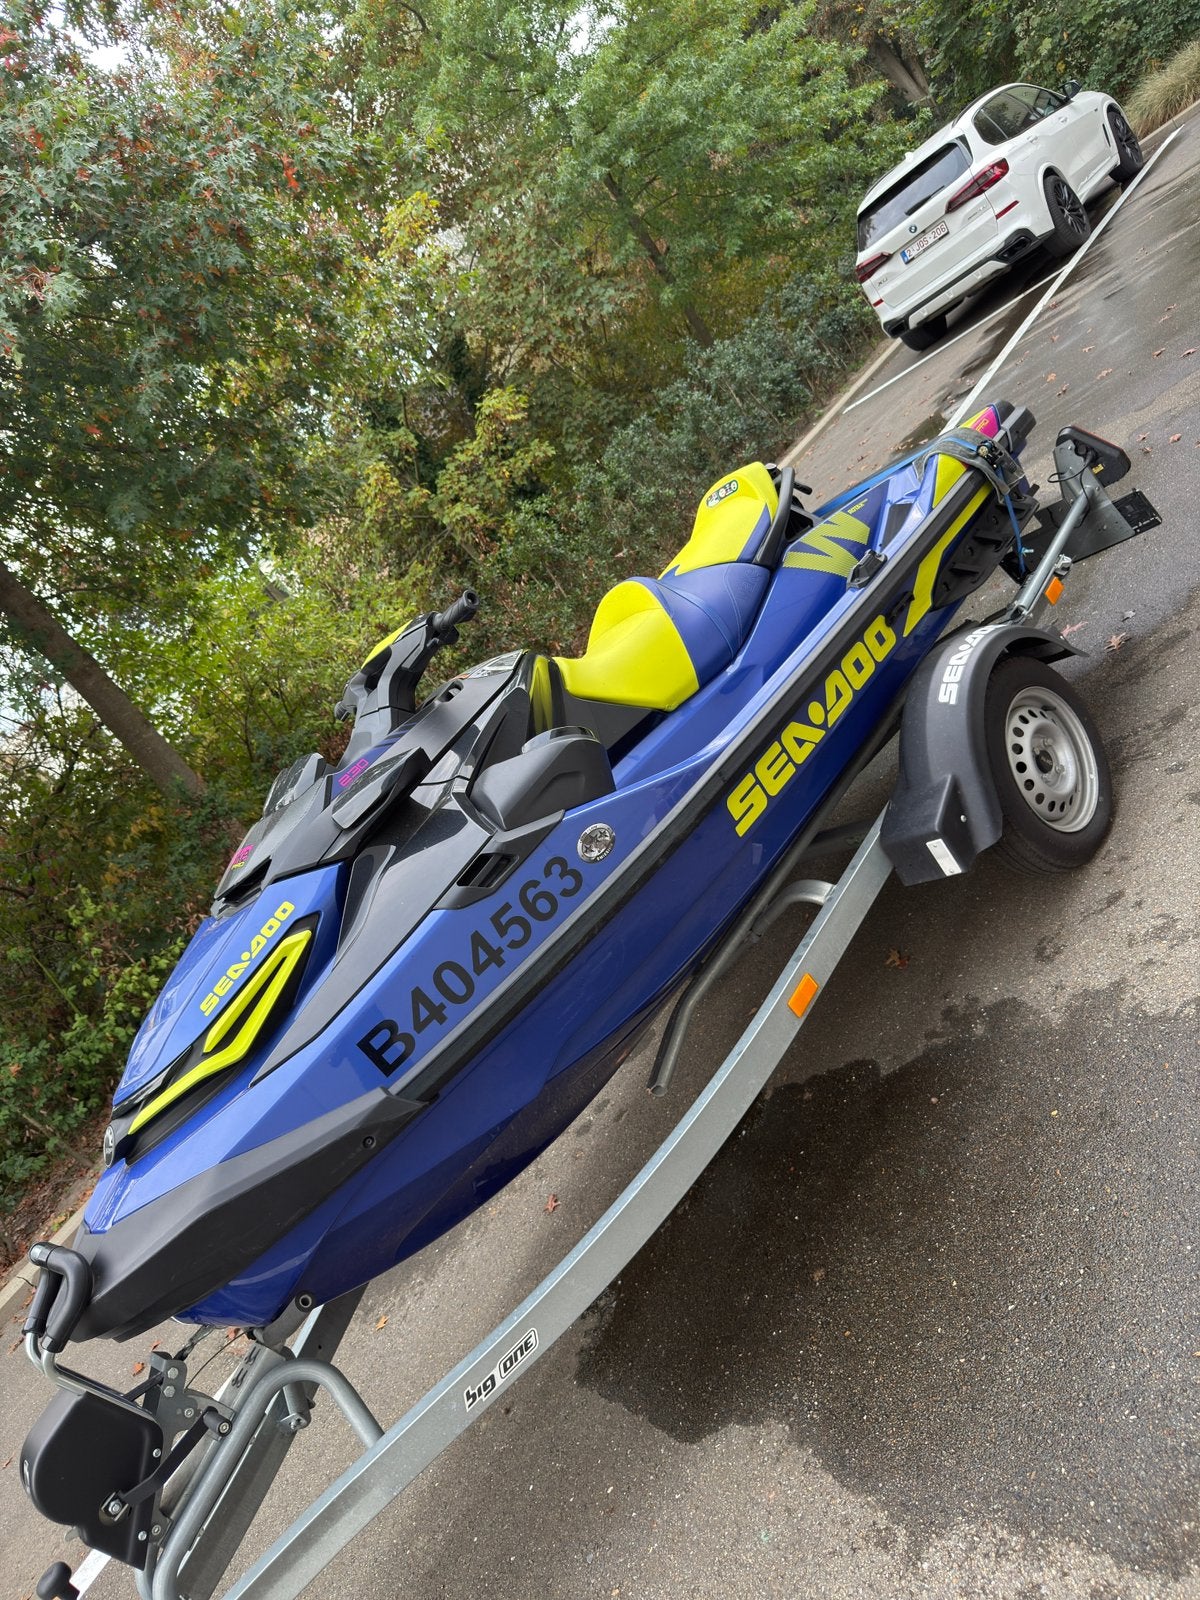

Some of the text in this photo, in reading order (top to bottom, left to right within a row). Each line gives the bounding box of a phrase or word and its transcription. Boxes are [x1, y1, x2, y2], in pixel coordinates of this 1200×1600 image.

[338, 758, 369, 787] 230
[356, 856, 583, 1078] B404563
[465, 1373, 496, 1409] big
